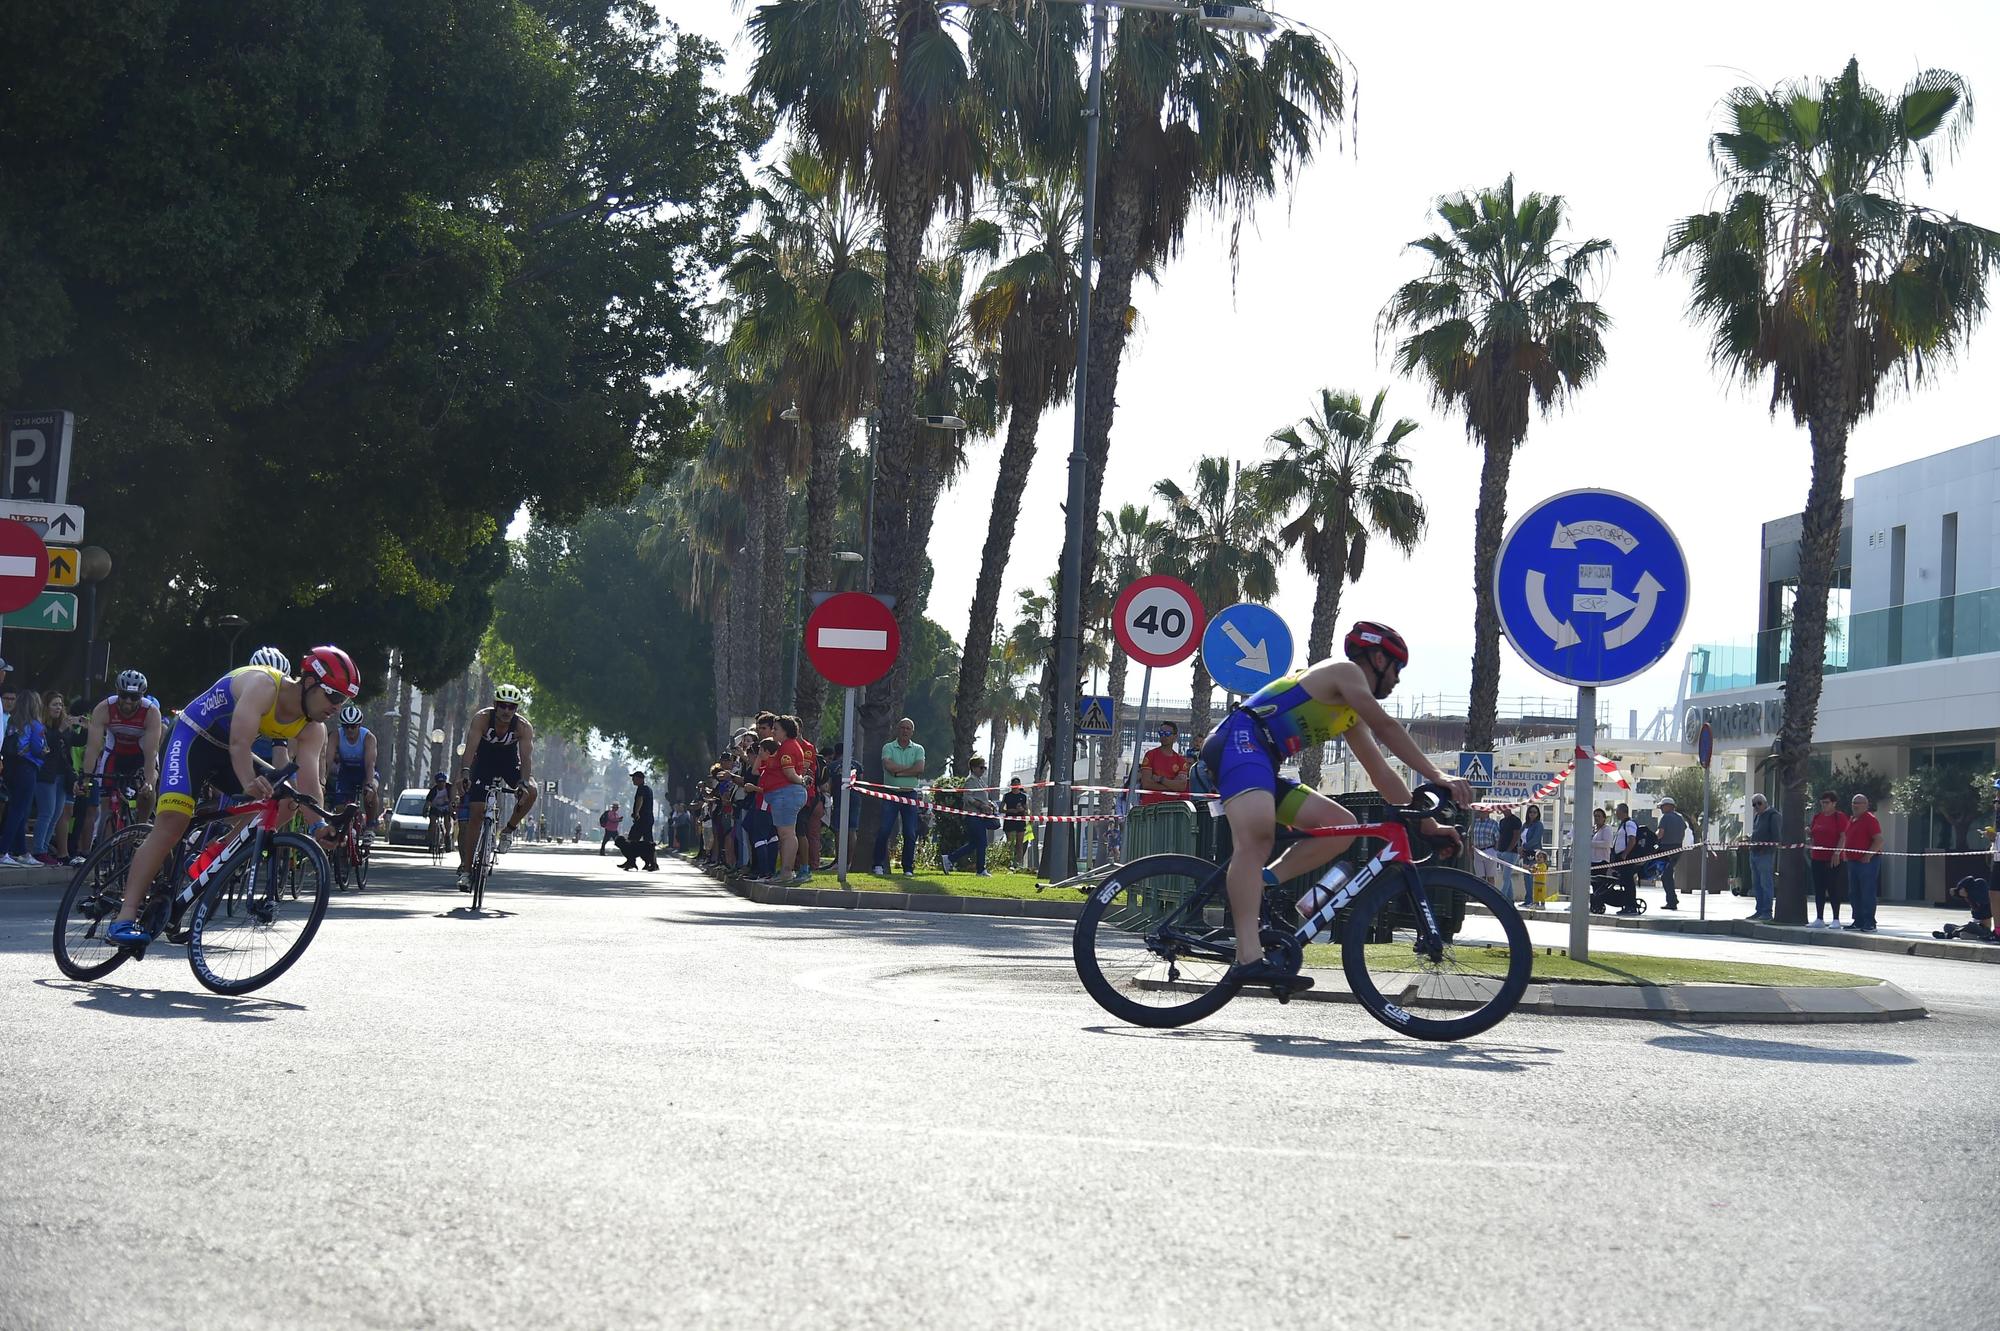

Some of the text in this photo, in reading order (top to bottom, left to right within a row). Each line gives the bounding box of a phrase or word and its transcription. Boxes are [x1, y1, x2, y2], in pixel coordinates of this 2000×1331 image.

[9, 428, 46, 495] P
[1133, 605, 1186, 638] 40
[1702, 701, 1762, 739] BURGER
[168, 740, 184, 786] aquario
[1496, 772, 1548, 780] del PUERTO
[546, 781, 556, 792] P
[175, 809, 264, 903] TREK
[1294, 841, 1401, 940] TREK
[1420, 899, 1440, 935] TREK
[192, 903, 235, 987] BONTRAGER
